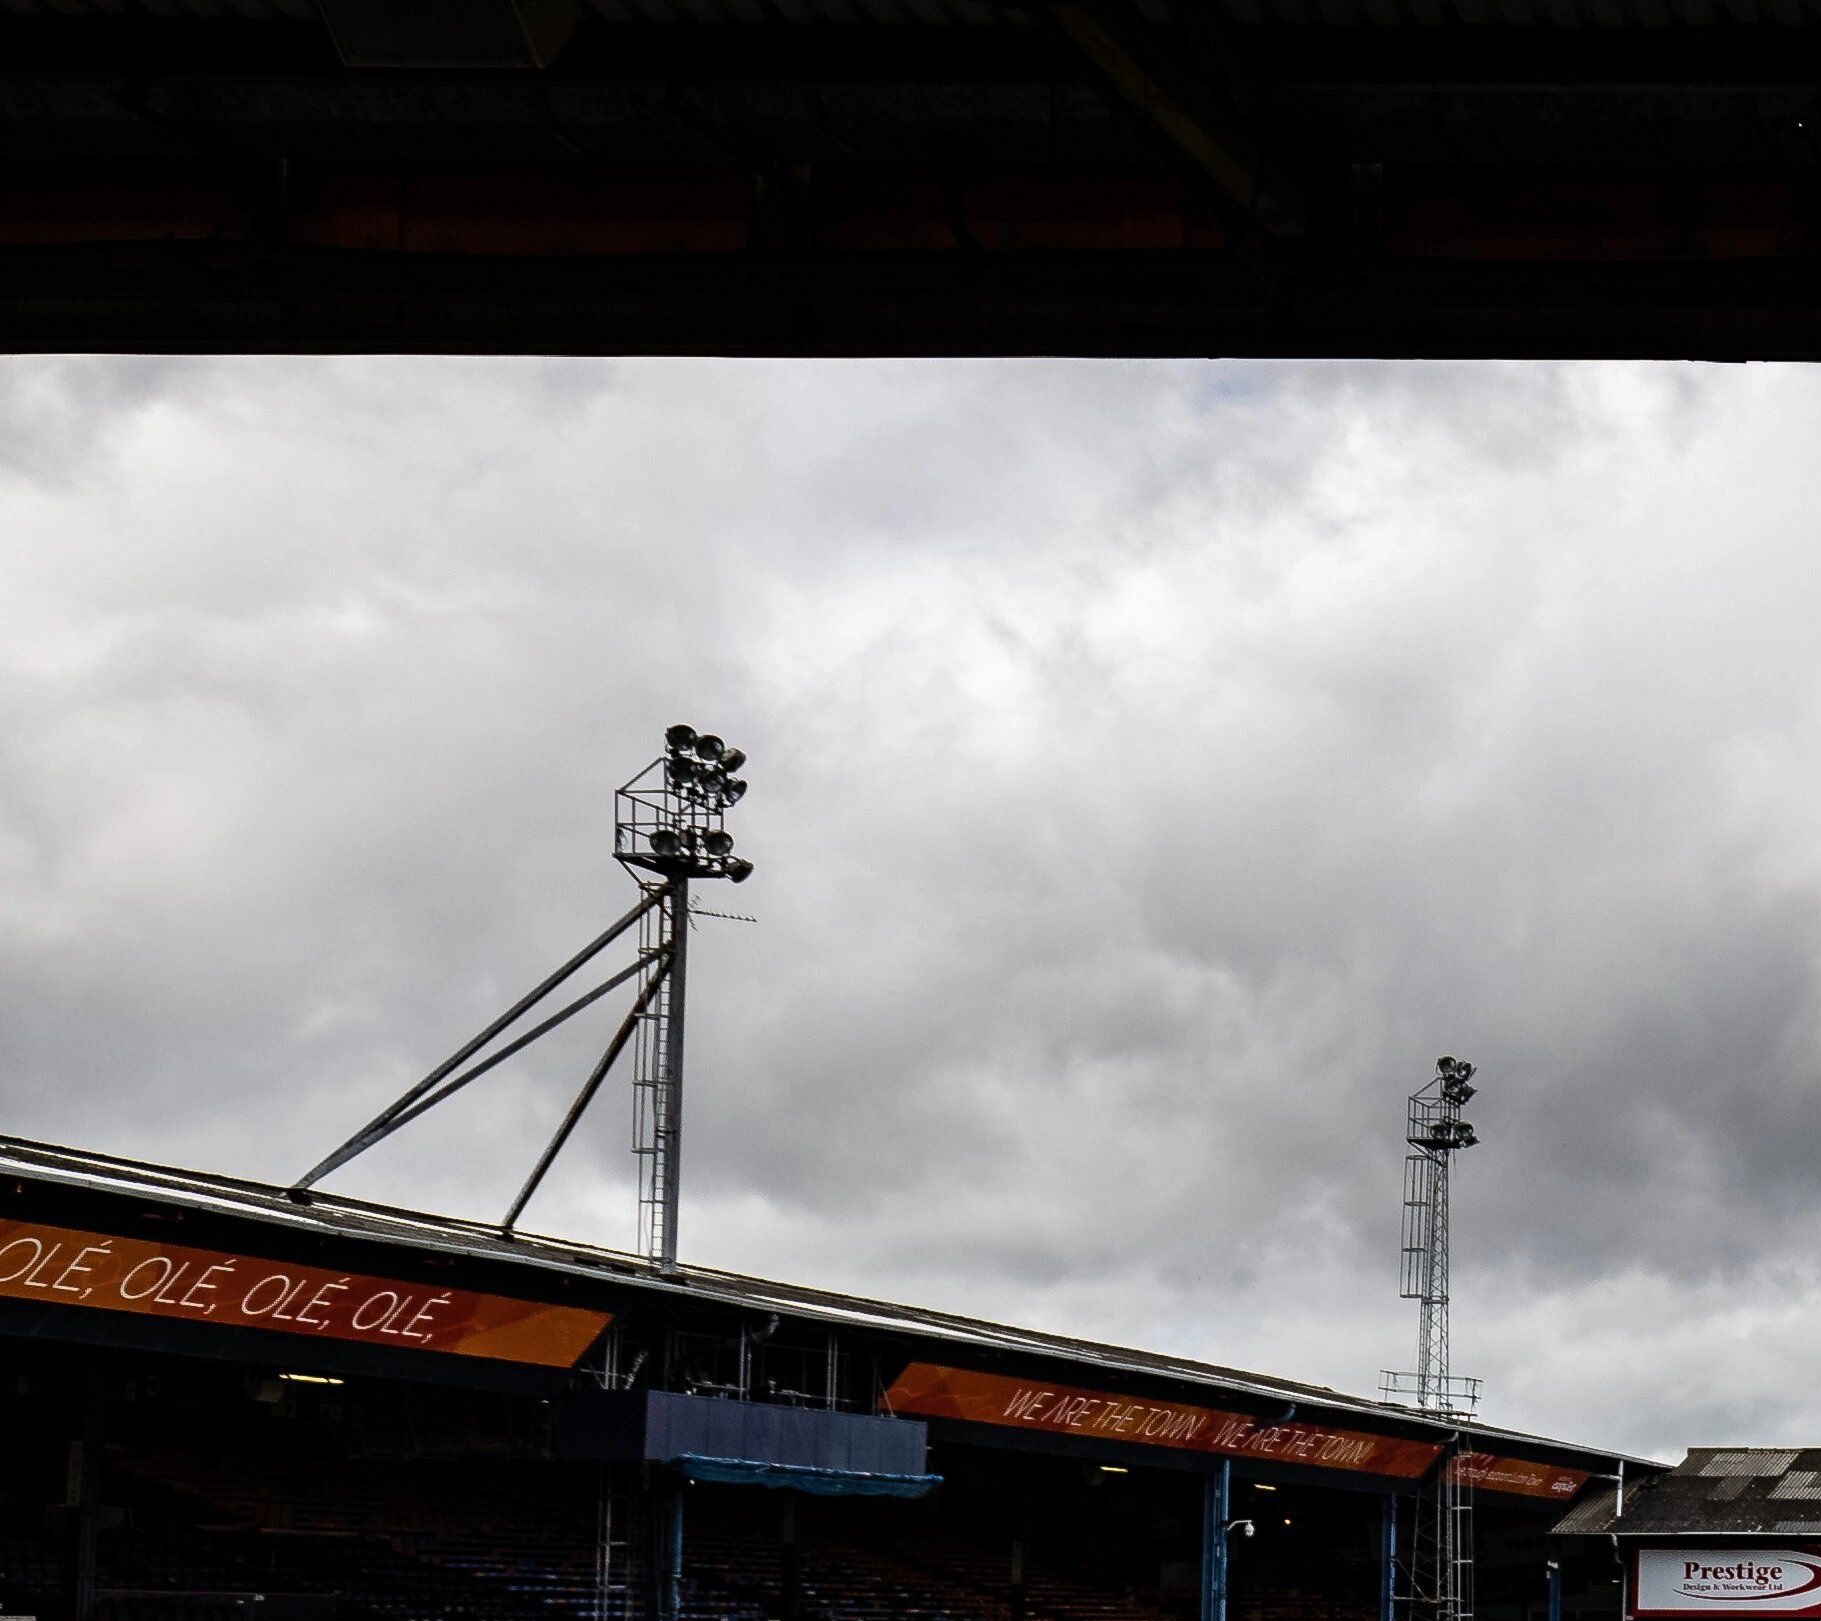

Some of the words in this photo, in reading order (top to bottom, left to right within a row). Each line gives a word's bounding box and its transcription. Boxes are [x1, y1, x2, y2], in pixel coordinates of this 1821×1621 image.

[0, 1238, 113, 1299] OLÉ,
[120, 1257, 239, 1315] OLÉ,
[241, 1275, 349, 1330] OLÉ,
[352, 1292, 451, 1344] OLÉ,
[1003, 1389, 1054, 1421] WE
[1041, 1395, 1090, 1427] ARE
[1092, 1400, 1144, 1433] THE
[1136, 1407, 1206, 1442] TOWN
[1212, 1418, 1254, 1448] WE
[1281, 1429, 1325, 1457] THE
[1683, 1561, 1782, 1586] Prestige
[1683, 1584, 1711, 1592] Design
